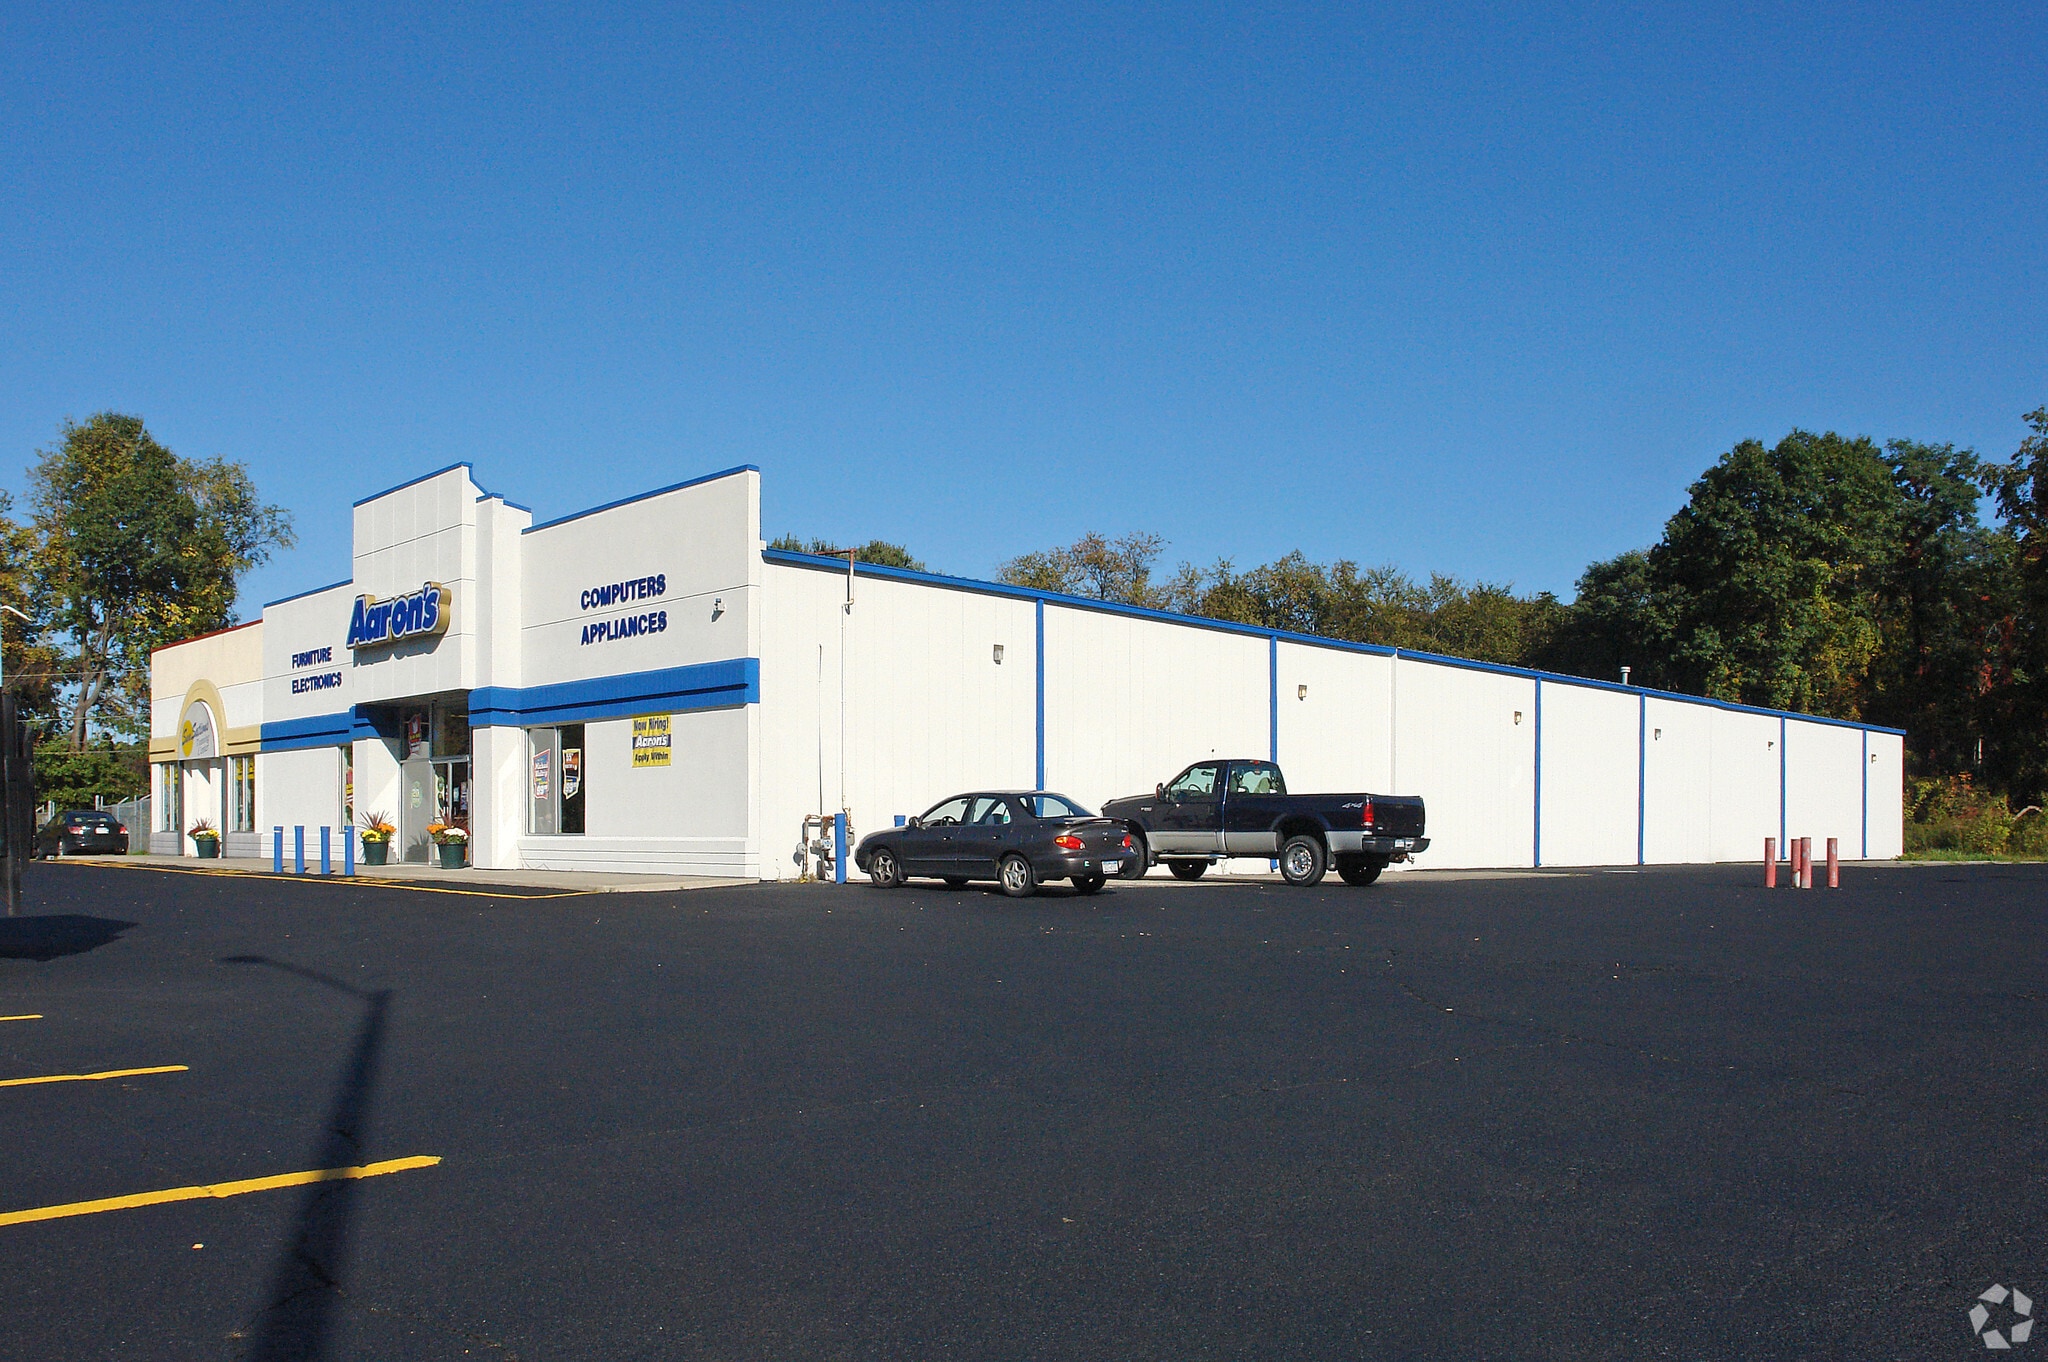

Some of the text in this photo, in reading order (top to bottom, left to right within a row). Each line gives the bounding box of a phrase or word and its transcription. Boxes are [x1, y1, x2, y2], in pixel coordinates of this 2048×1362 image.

[581, 574, 666, 610] COMPUTERS
[346, 583, 440, 648] Aaron's
[581, 611, 667, 646] APPLIANCES
[292, 647, 332, 669] FURNITURE
[292, 672, 342, 694] ELECTRONICS
[634, 717, 669, 732] Now Hiring!
[635, 734, 668, 748] Aaron's
[635, 752, 669, 763] Apply Within
